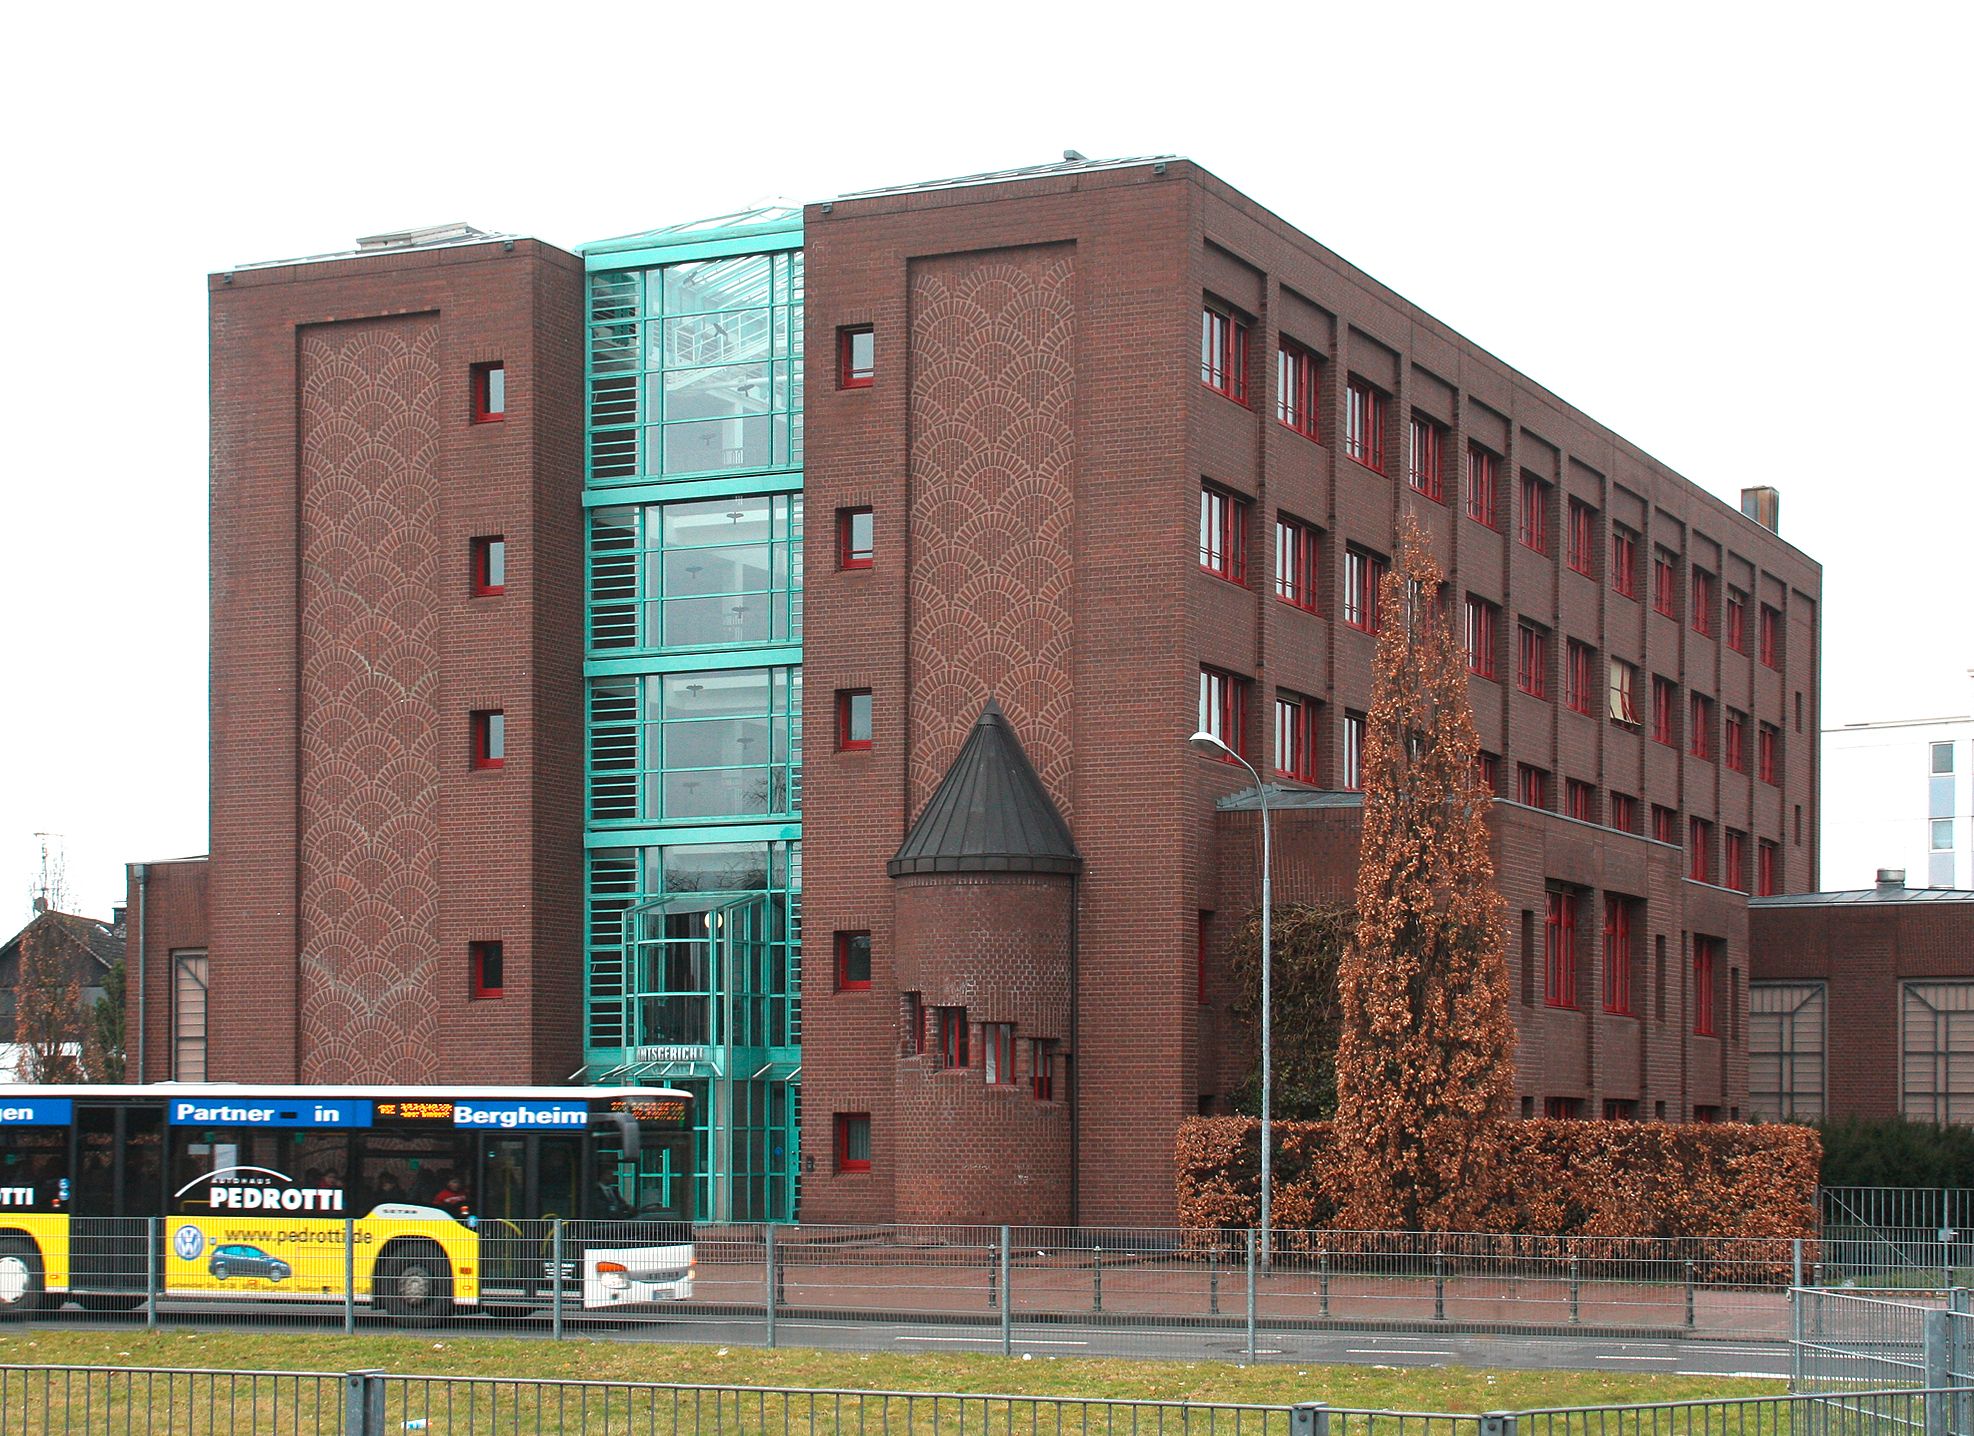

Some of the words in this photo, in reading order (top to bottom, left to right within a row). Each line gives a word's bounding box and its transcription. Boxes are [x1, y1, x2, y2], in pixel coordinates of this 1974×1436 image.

[0, 1107, 34, 1123] en
[177, 1104, 275, 1121] Partner
[314, 1106, 340, 1122] in
[453, 1107, 588, 1127] Bergheim
[0, 1187, 34, 1205] TTI
[210, 1187, 343, 1210] PEDROTTI
[224, 1227, 372, 1246] www.pedrottide
